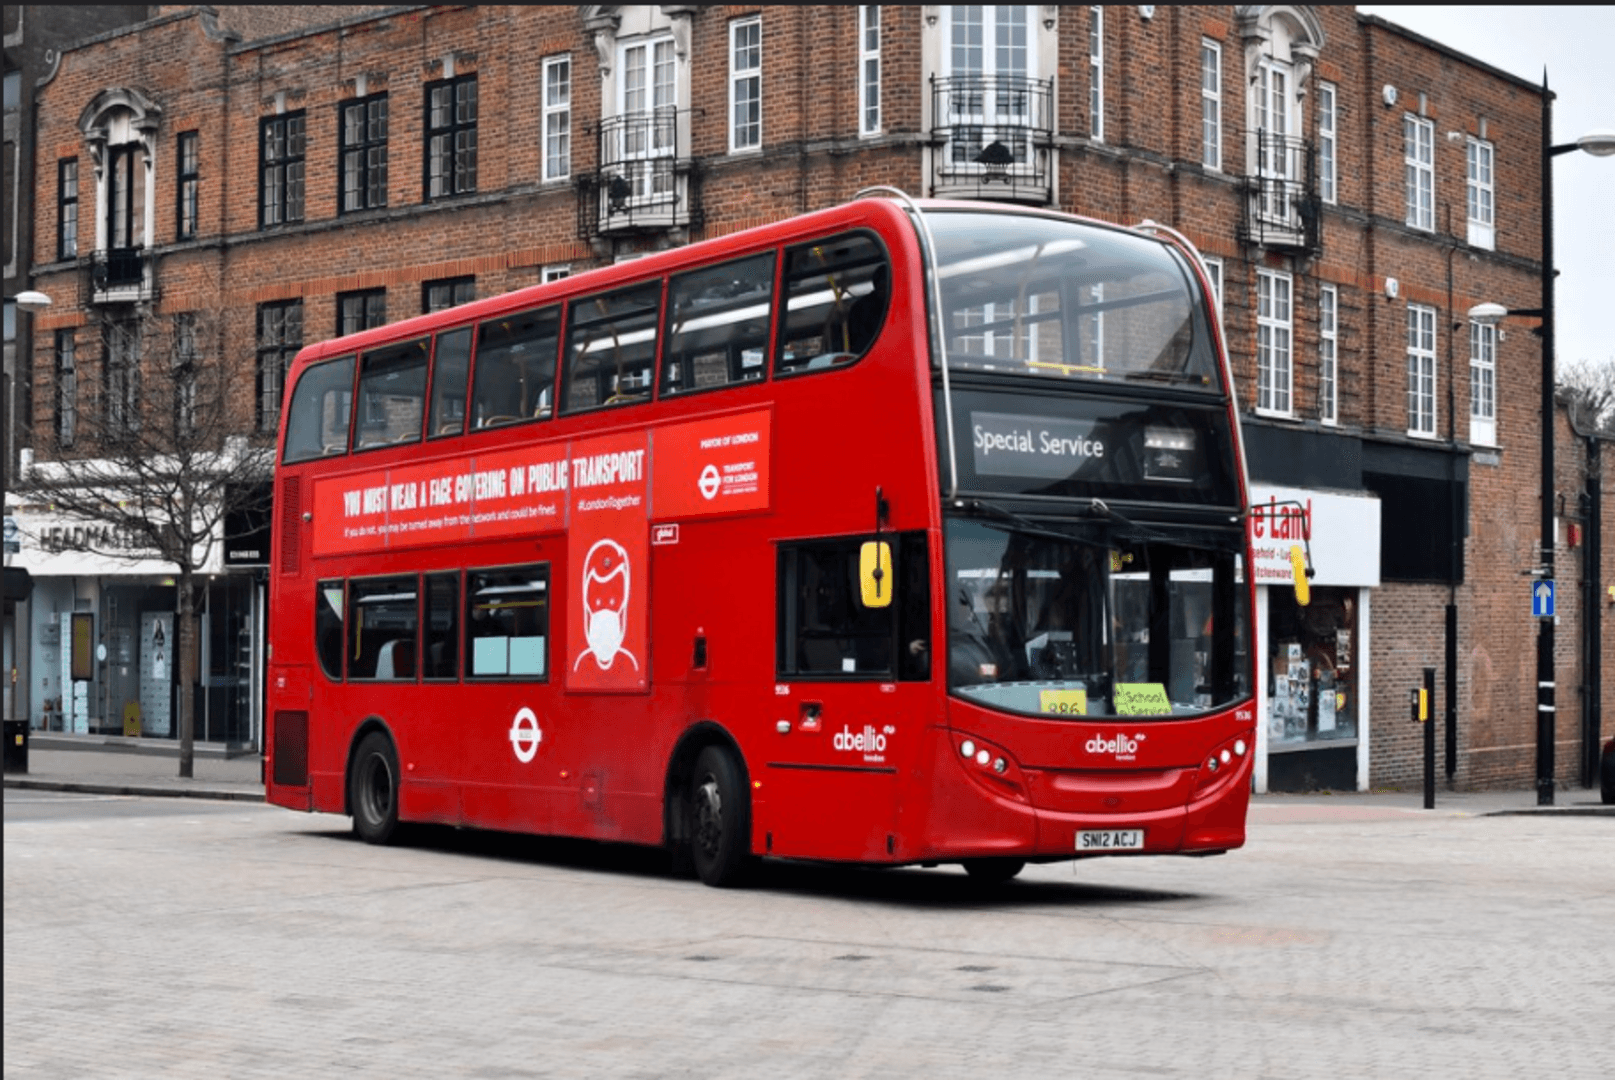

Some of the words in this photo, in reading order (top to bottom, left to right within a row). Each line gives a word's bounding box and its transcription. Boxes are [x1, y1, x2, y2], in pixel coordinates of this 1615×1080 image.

[721, 435, 731, 447] OF
[731, 431, 759, 445] LONDON
[973, 424, 1035, 456] Special
[1040, 430, 1104, 458] Service
[723, 461, 755, 473] TRANSPORT
[343, 488, 361, 517] YOU
[363, 485, 389, 515] MUST
[391, 481, 417, 511] WEAR
[420, 480, 427, 508] A
[429, 476, 452, 507] FACE
[455, 468, 506, 502] COVERING
[510, 465, 525, 497] ON
[528, 459, 568, 494] PUBLIC
[572, 449, 645, 488] TRANSPORT
[723, 474, 734, 484] FOR
[734, 472, 759, 483] LONDON
[578, 495, 641, 511] #LondonTogether
[1270, 494, 1311, 541] Land
[833, 723, 887, 752] abellio
[1085, 732, 1138, 753] abellio
[1082, 832, 1110, 847] SN12
[1113, 831, 1138, 847] ACJ
